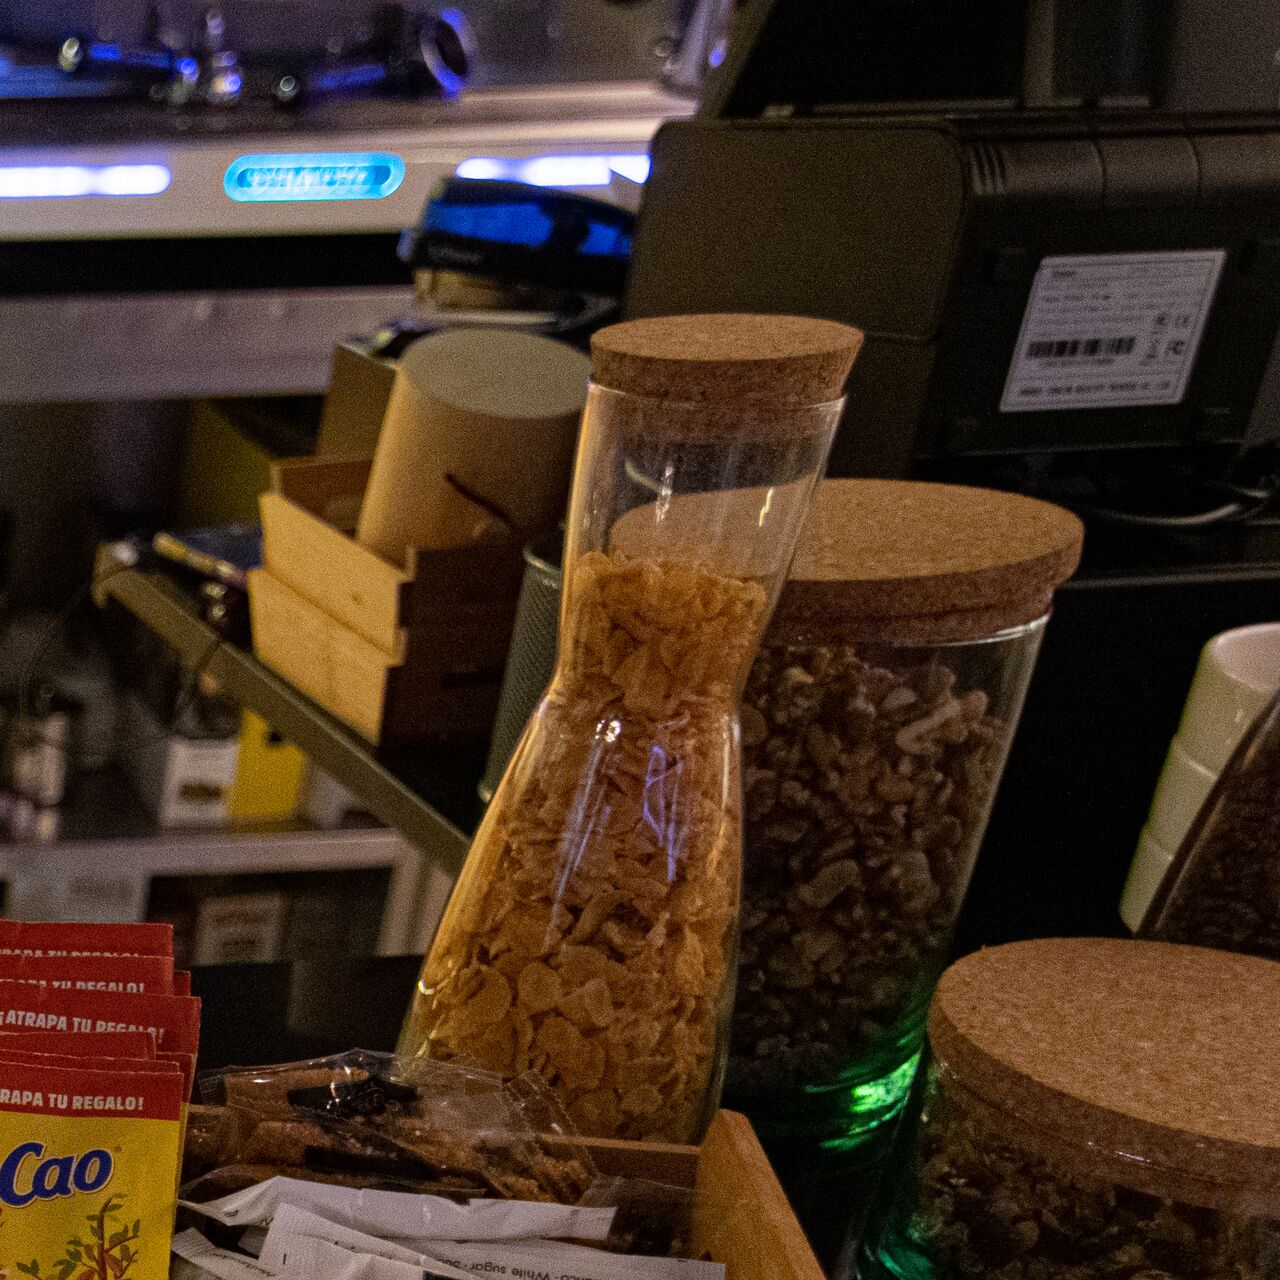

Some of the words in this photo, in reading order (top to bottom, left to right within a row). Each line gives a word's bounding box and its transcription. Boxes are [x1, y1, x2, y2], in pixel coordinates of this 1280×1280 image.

[71, 1016, 92, 1034] TU
[47, 1093, 69, 1109] TU
[72, 1095, 145, 1111] REGALO!
[470, 1259, 507, 1276] sugar
